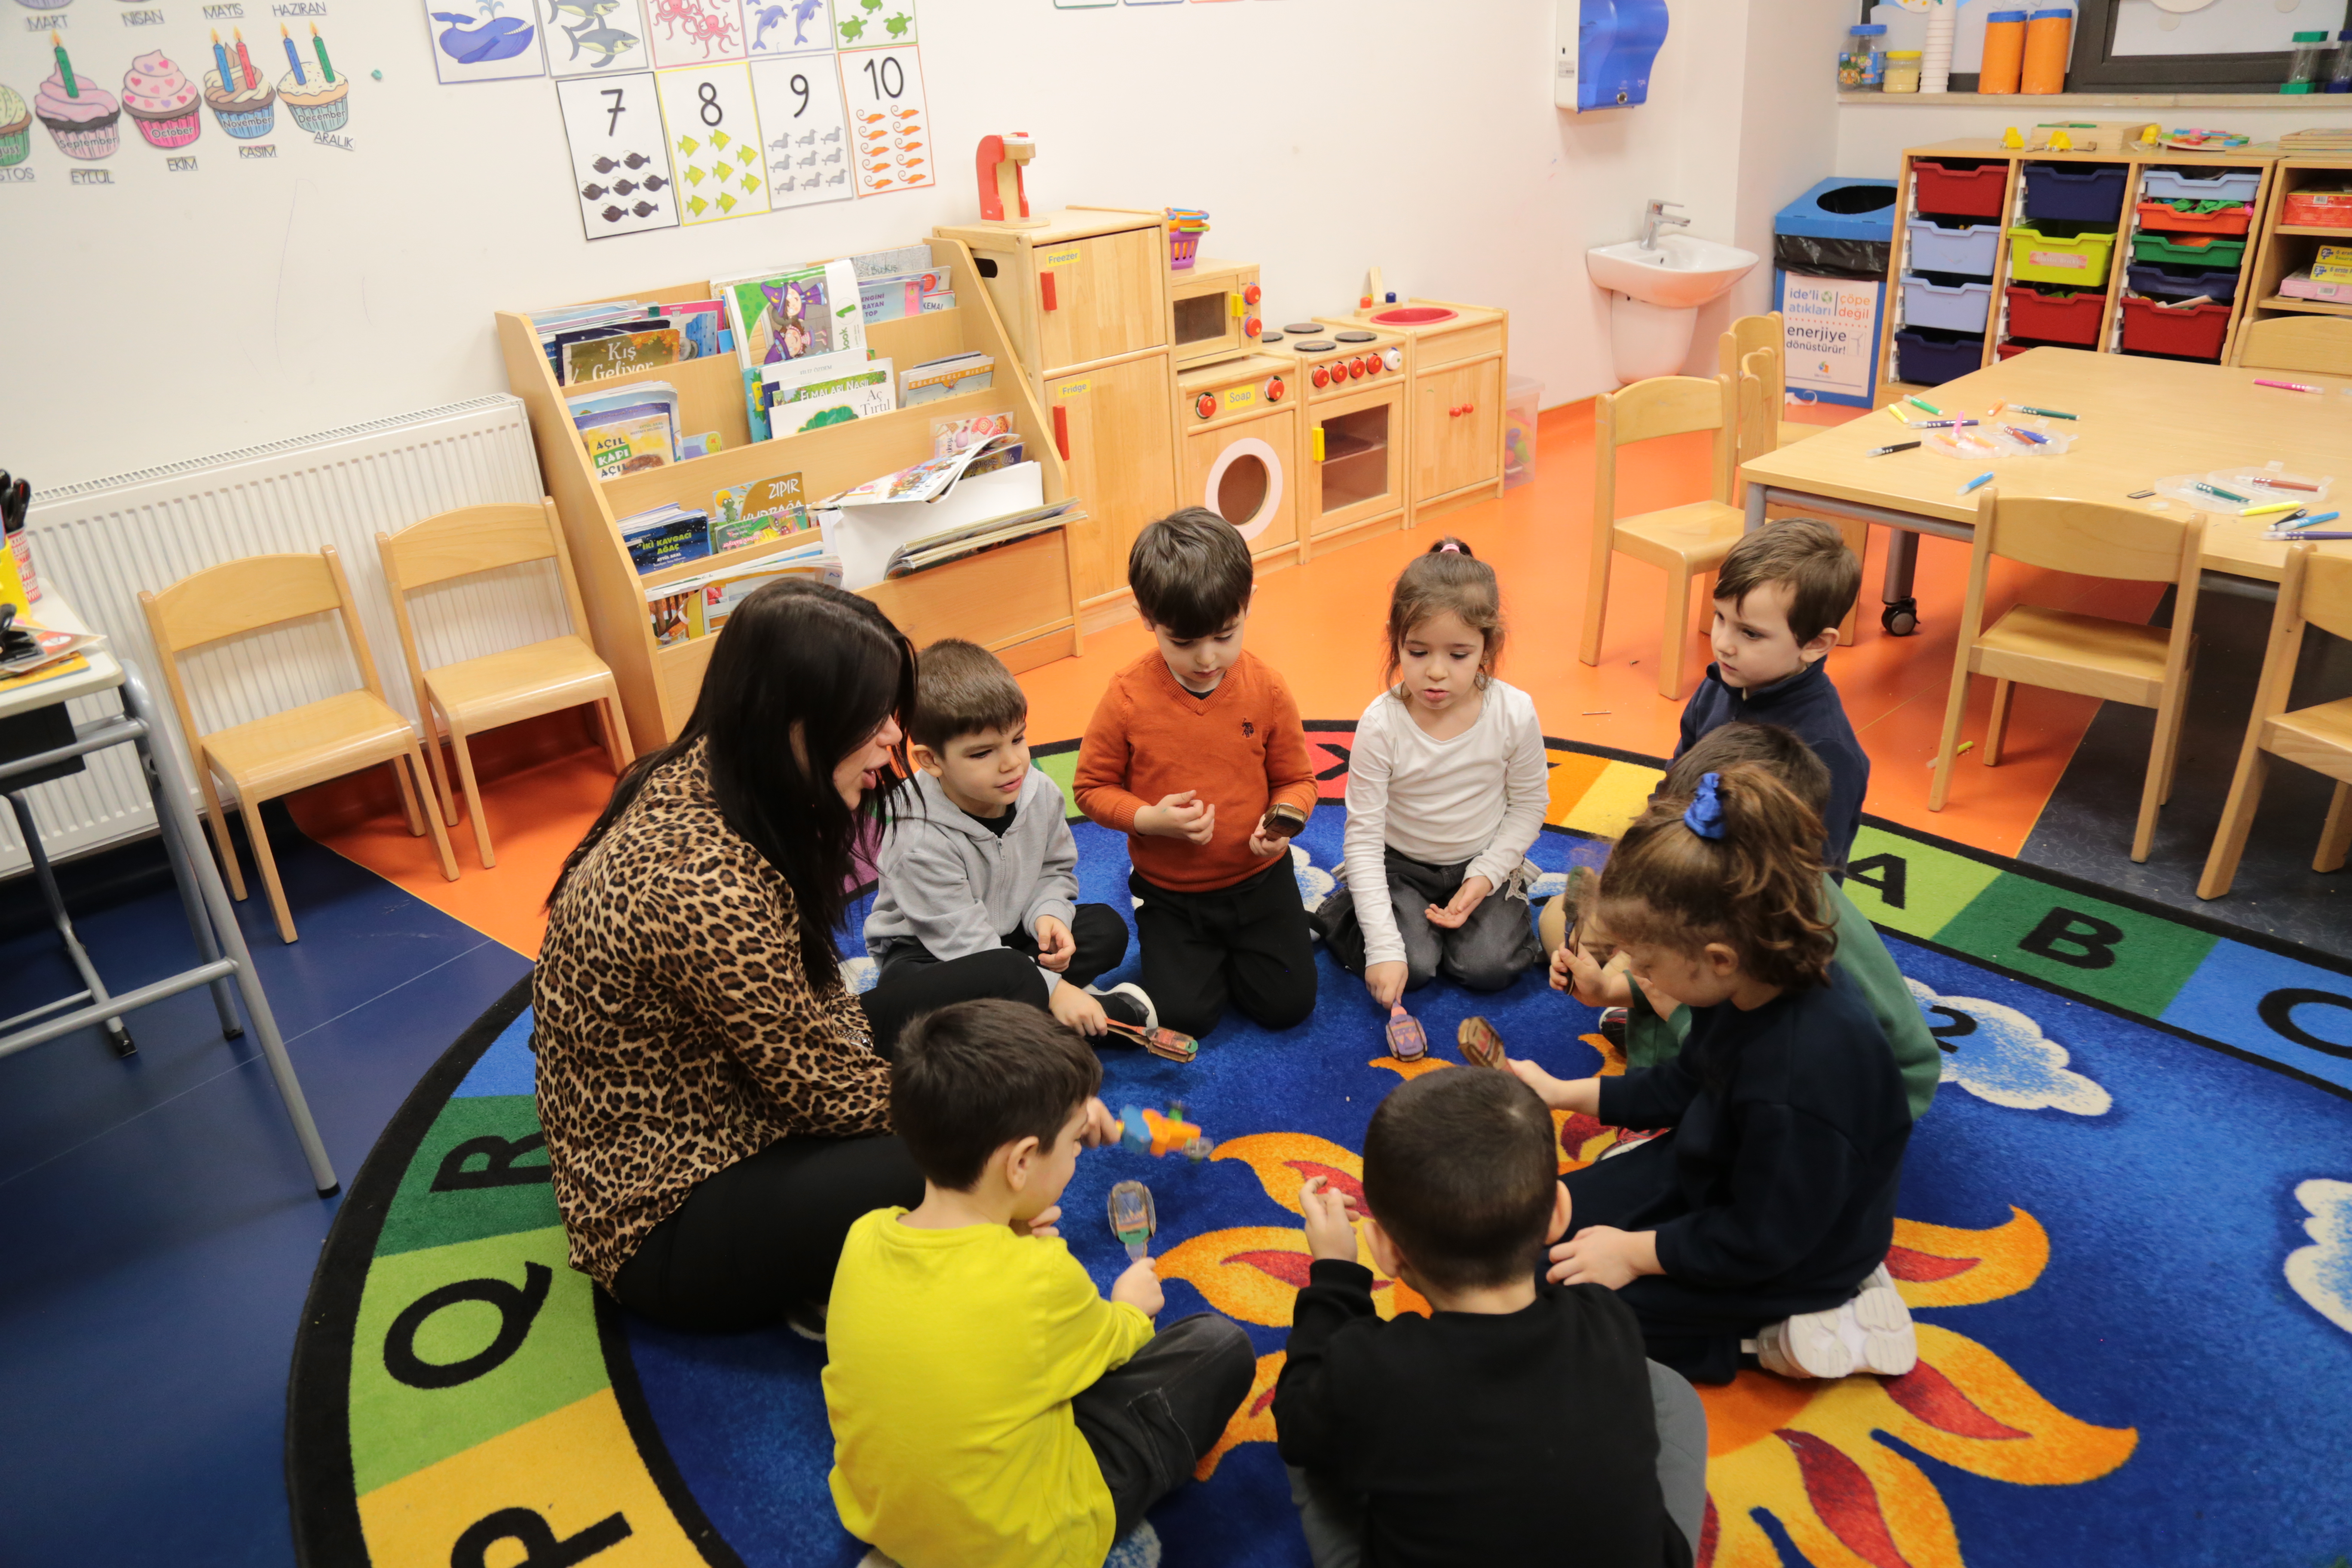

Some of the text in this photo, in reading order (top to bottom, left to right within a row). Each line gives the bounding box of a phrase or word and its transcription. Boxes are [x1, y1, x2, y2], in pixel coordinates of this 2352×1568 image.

[202, 3, 243, 18] MAYIS
[27, 15, 68, 30] MART
[864, 57, 904, 100] 10
[790, 74, 810, 118] 9
[698, 82, 723, 126] 8
[298, 110, 346, 123] December
[600, 89, 626, 136] 7
[224, 116, 272, 128] November
[152, 127, 193, 138] October
[59, 136, 117, 150] September
[314, 132, 353, 149] ARALIK
[239, 145, 276, 157] KASIM
[0, 167, 34, 181] STOS
[71, 170, 115, 184] EYLÜL
[1048, 251, 1078, 264] Freezer
[861, 293, 885, 303] ENGİNİ
[1790, 288, 1819, 300] ide'li
[1840, 294, 1870, 306] çöpe
[862, 301, 884, 310] RAYAN
[1789, 303, 1831, 315] atıkları
[1839, 307, 1869, 320] değil
[1787, 326, 1847, 343] enerjiye
[608, 342, 637, 361] Kış
[867, 389, 883, 402] Aç
[1062, 383, 1087, 395] Fridge
[1230, 391, 1251, 404] Soap
[860, 399, 890, 416] Tırtıl
[597, 437, 625, 450] AÇIL
[597, 448, 629, 466] KAPI
[1002, 453, 1014, 466] Lila
[601, 463, 630, 478] AÇIL
[768, 478, 800, 499] ZIPIR
[656, 532, 692, 546] KAVGACI
[657, 543, 680, 554] AĞAÇ
[1847, 853, 1907, 910] A
[2018, 906, 2125, 970] B
[430, 1131, 553, 1193] R
[383, 1261, 552, 1390] Q
[450, 1507, 633, 1568] P
